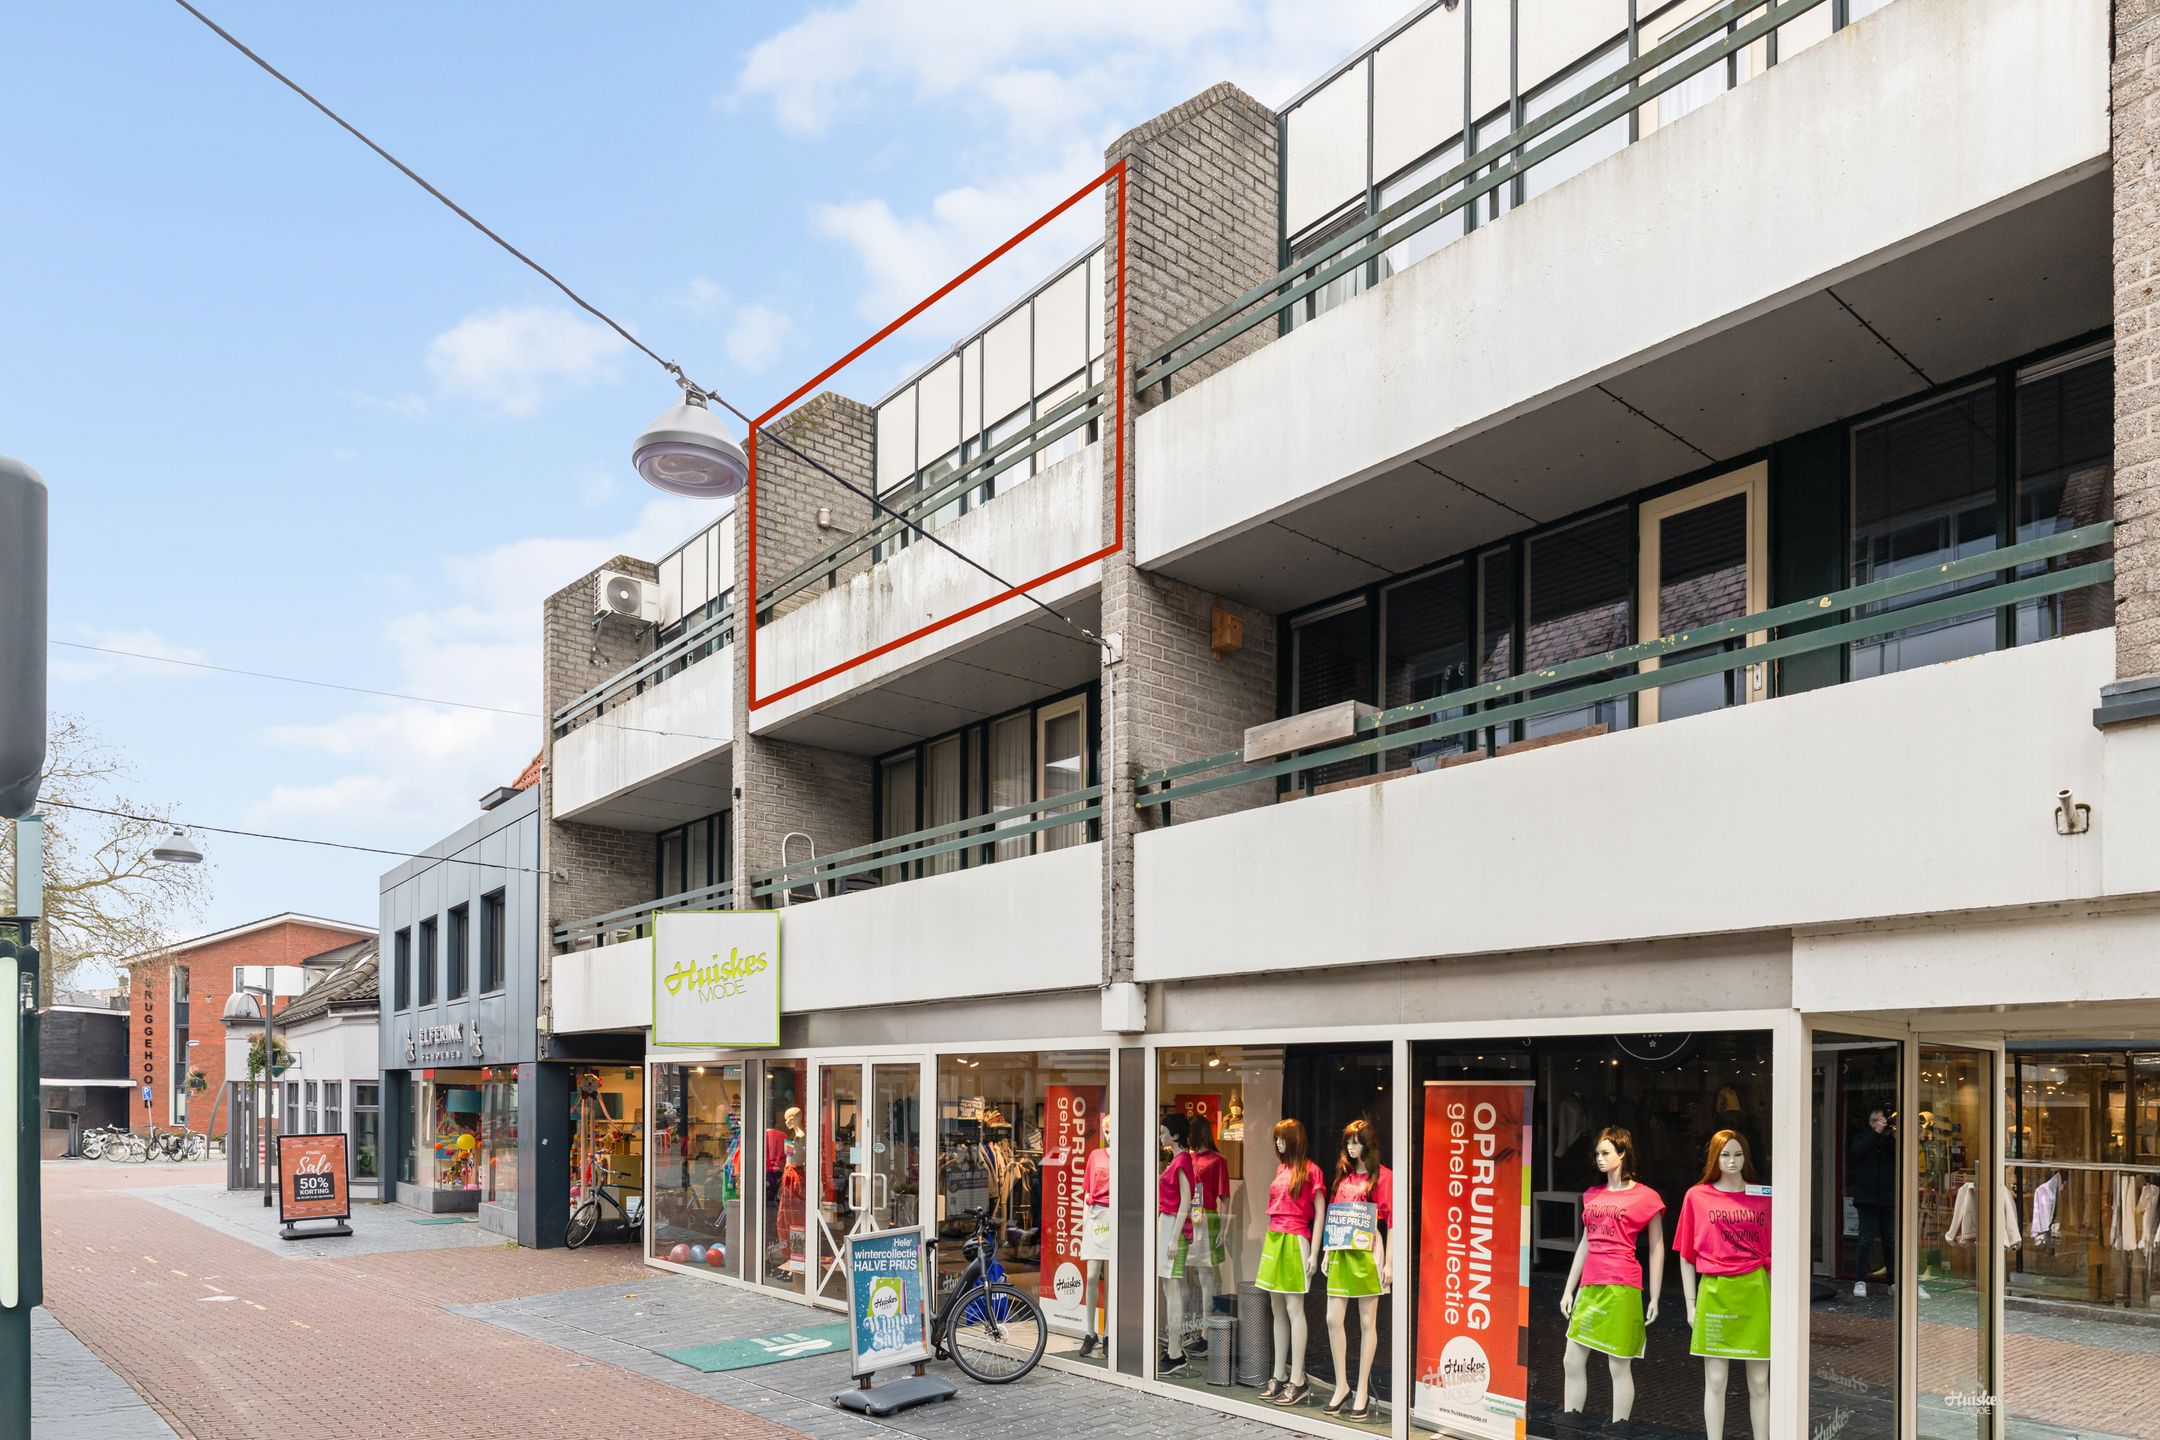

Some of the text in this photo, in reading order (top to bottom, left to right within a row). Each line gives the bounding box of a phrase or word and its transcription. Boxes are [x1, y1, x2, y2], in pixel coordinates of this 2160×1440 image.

[664, 947, 768, 995] Huiskes
[698, 979, 747, 1003] MODE
[419, 1022, 463, 1045] ELFERINK
[296, 1154, 333, 1175] Sale
[1056, 1096, 1070, 1255] gehele collectie
[300, 1177, 329, 1189] 50%
[1070, 1096, 1087, 1258] OPRUIMING
[1328, 1215, 1370, 1228] HALVE PRIJS
[1444, 1103, 1469, 1325] gehele collectie
[1467, 1102, 1497, 1330] OPRUIMING
[1708, 1209, 1765, 1227] OPRUIMING
[854, 1248, 917, 1259] wintercollectie
[854, 1259, 917, 1272] HALVE PRIJS
[1056, 1275, 1081, 1290] Huiskes
[863, 1312, 915, 1334] Winter
[872, 1329, 905, 1351] Sale
[1444, 1357, 1485, 1374] Huiskes
